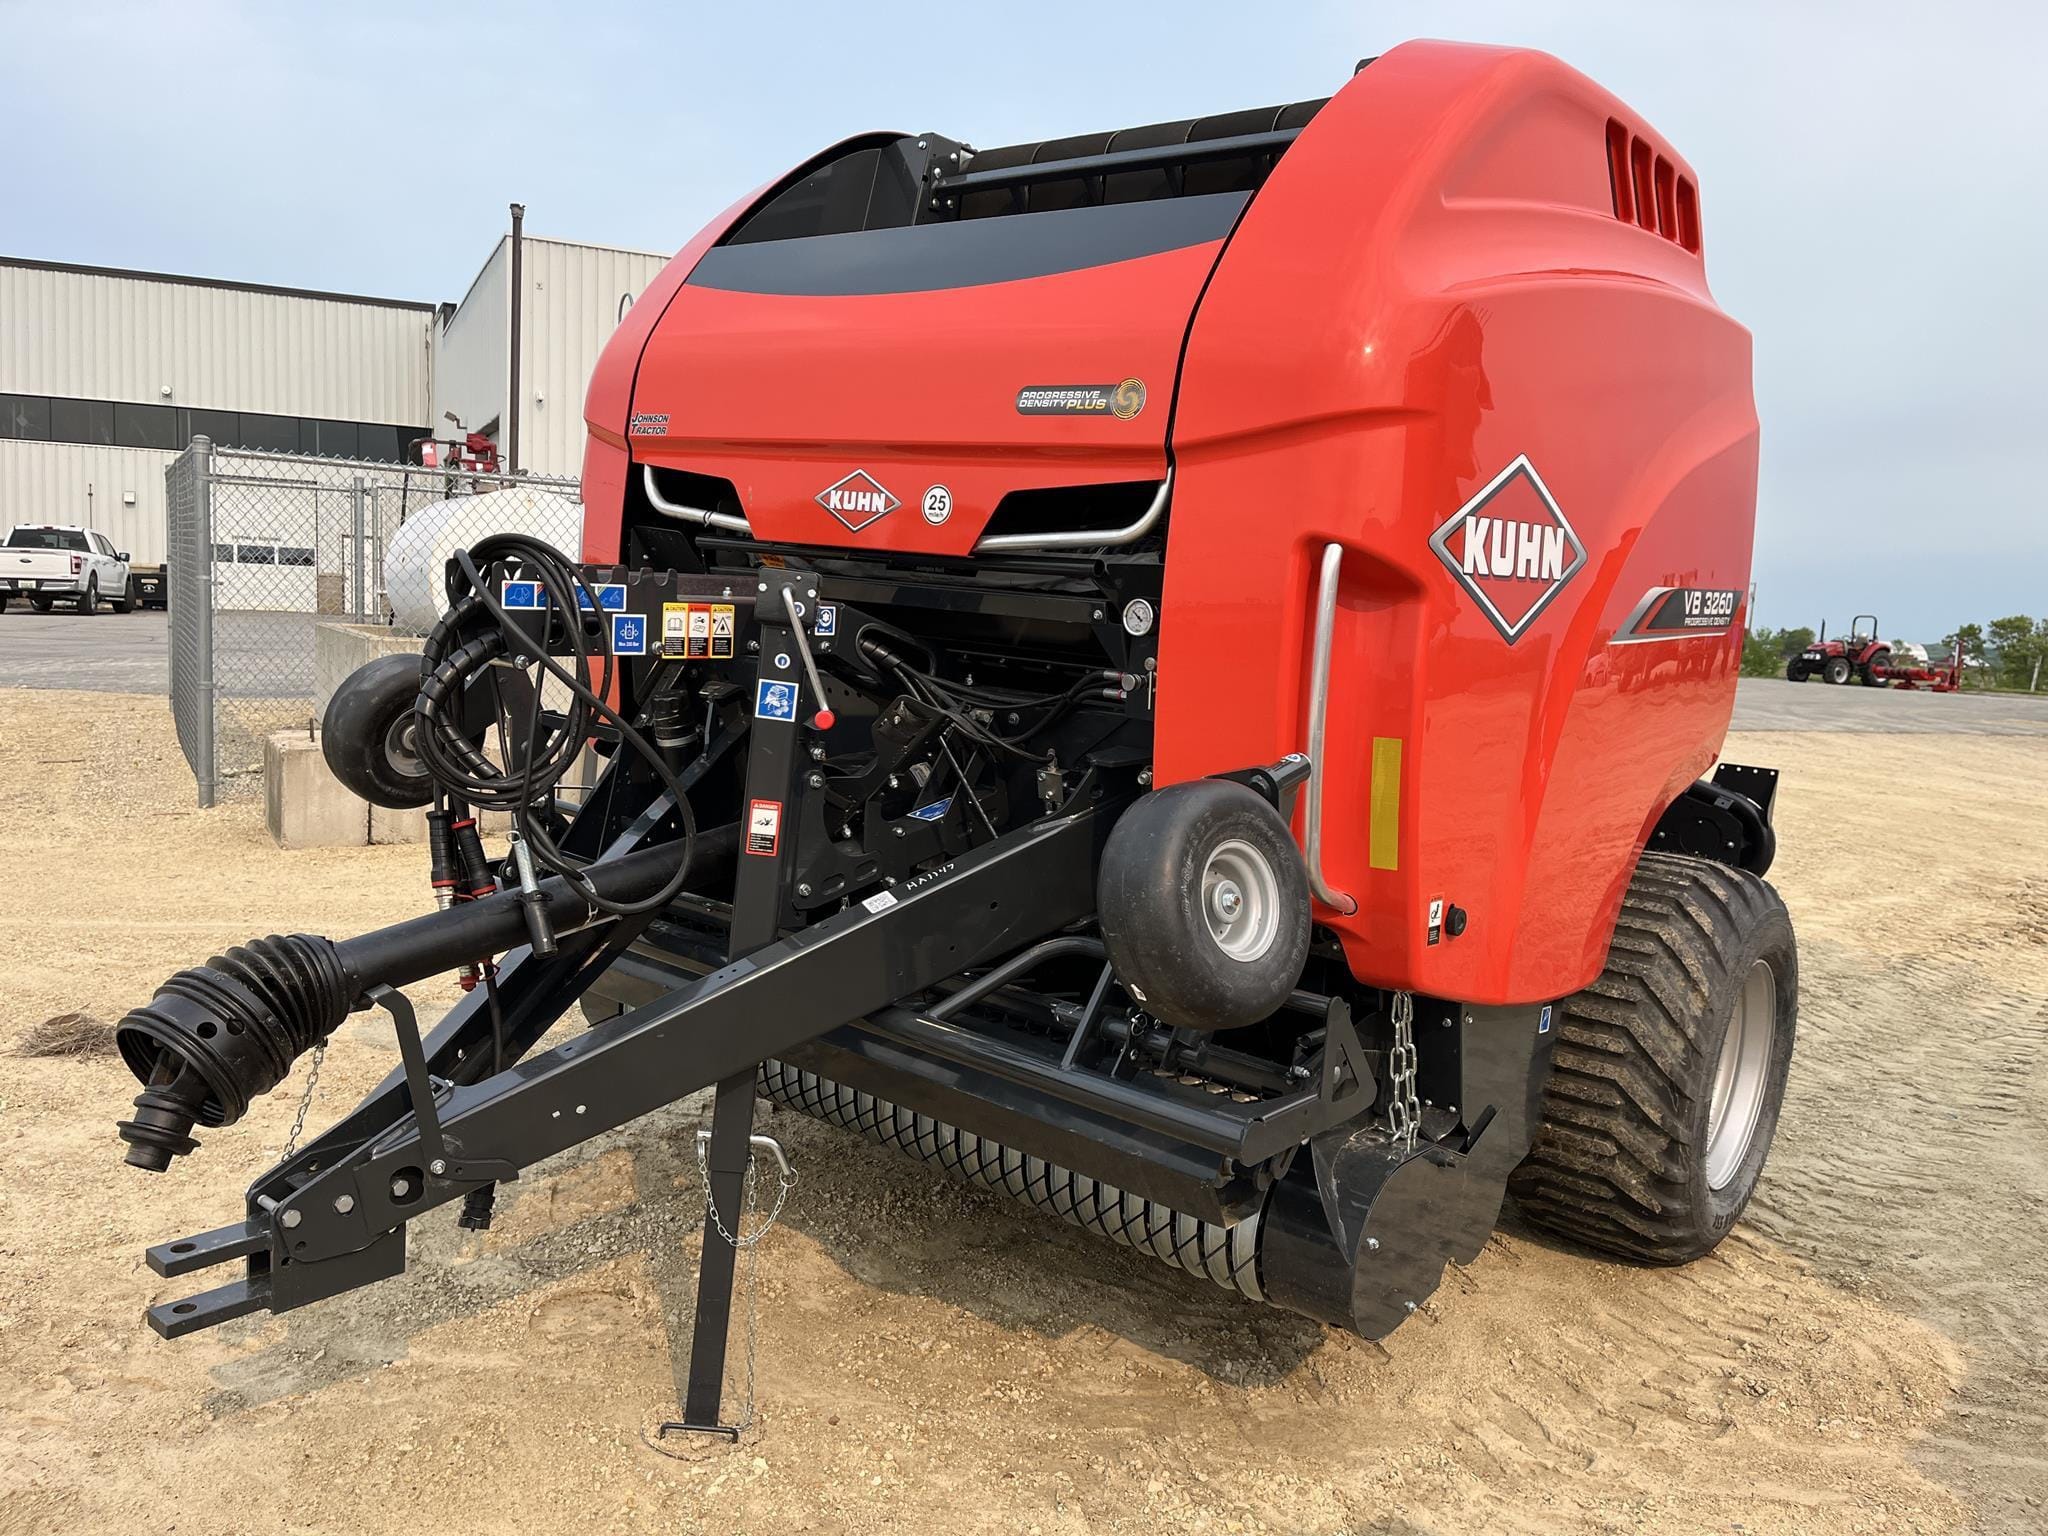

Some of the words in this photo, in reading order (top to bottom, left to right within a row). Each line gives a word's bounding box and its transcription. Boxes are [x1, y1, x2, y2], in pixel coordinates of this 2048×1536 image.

[1021, 390, 1101, 399] PROGRESSIVE
[631, 412, 669, 423] JOHNSON
[631, 423, 667, 435] TRACTOR
[829, 489, 886, 513] KUHN
[928, 494, 946, 511] 25
[1463, 515, 1565, 581] KUHN
[1684, 590, 1702, 615] VB
[1703, 591, 1734, 615] 3260
